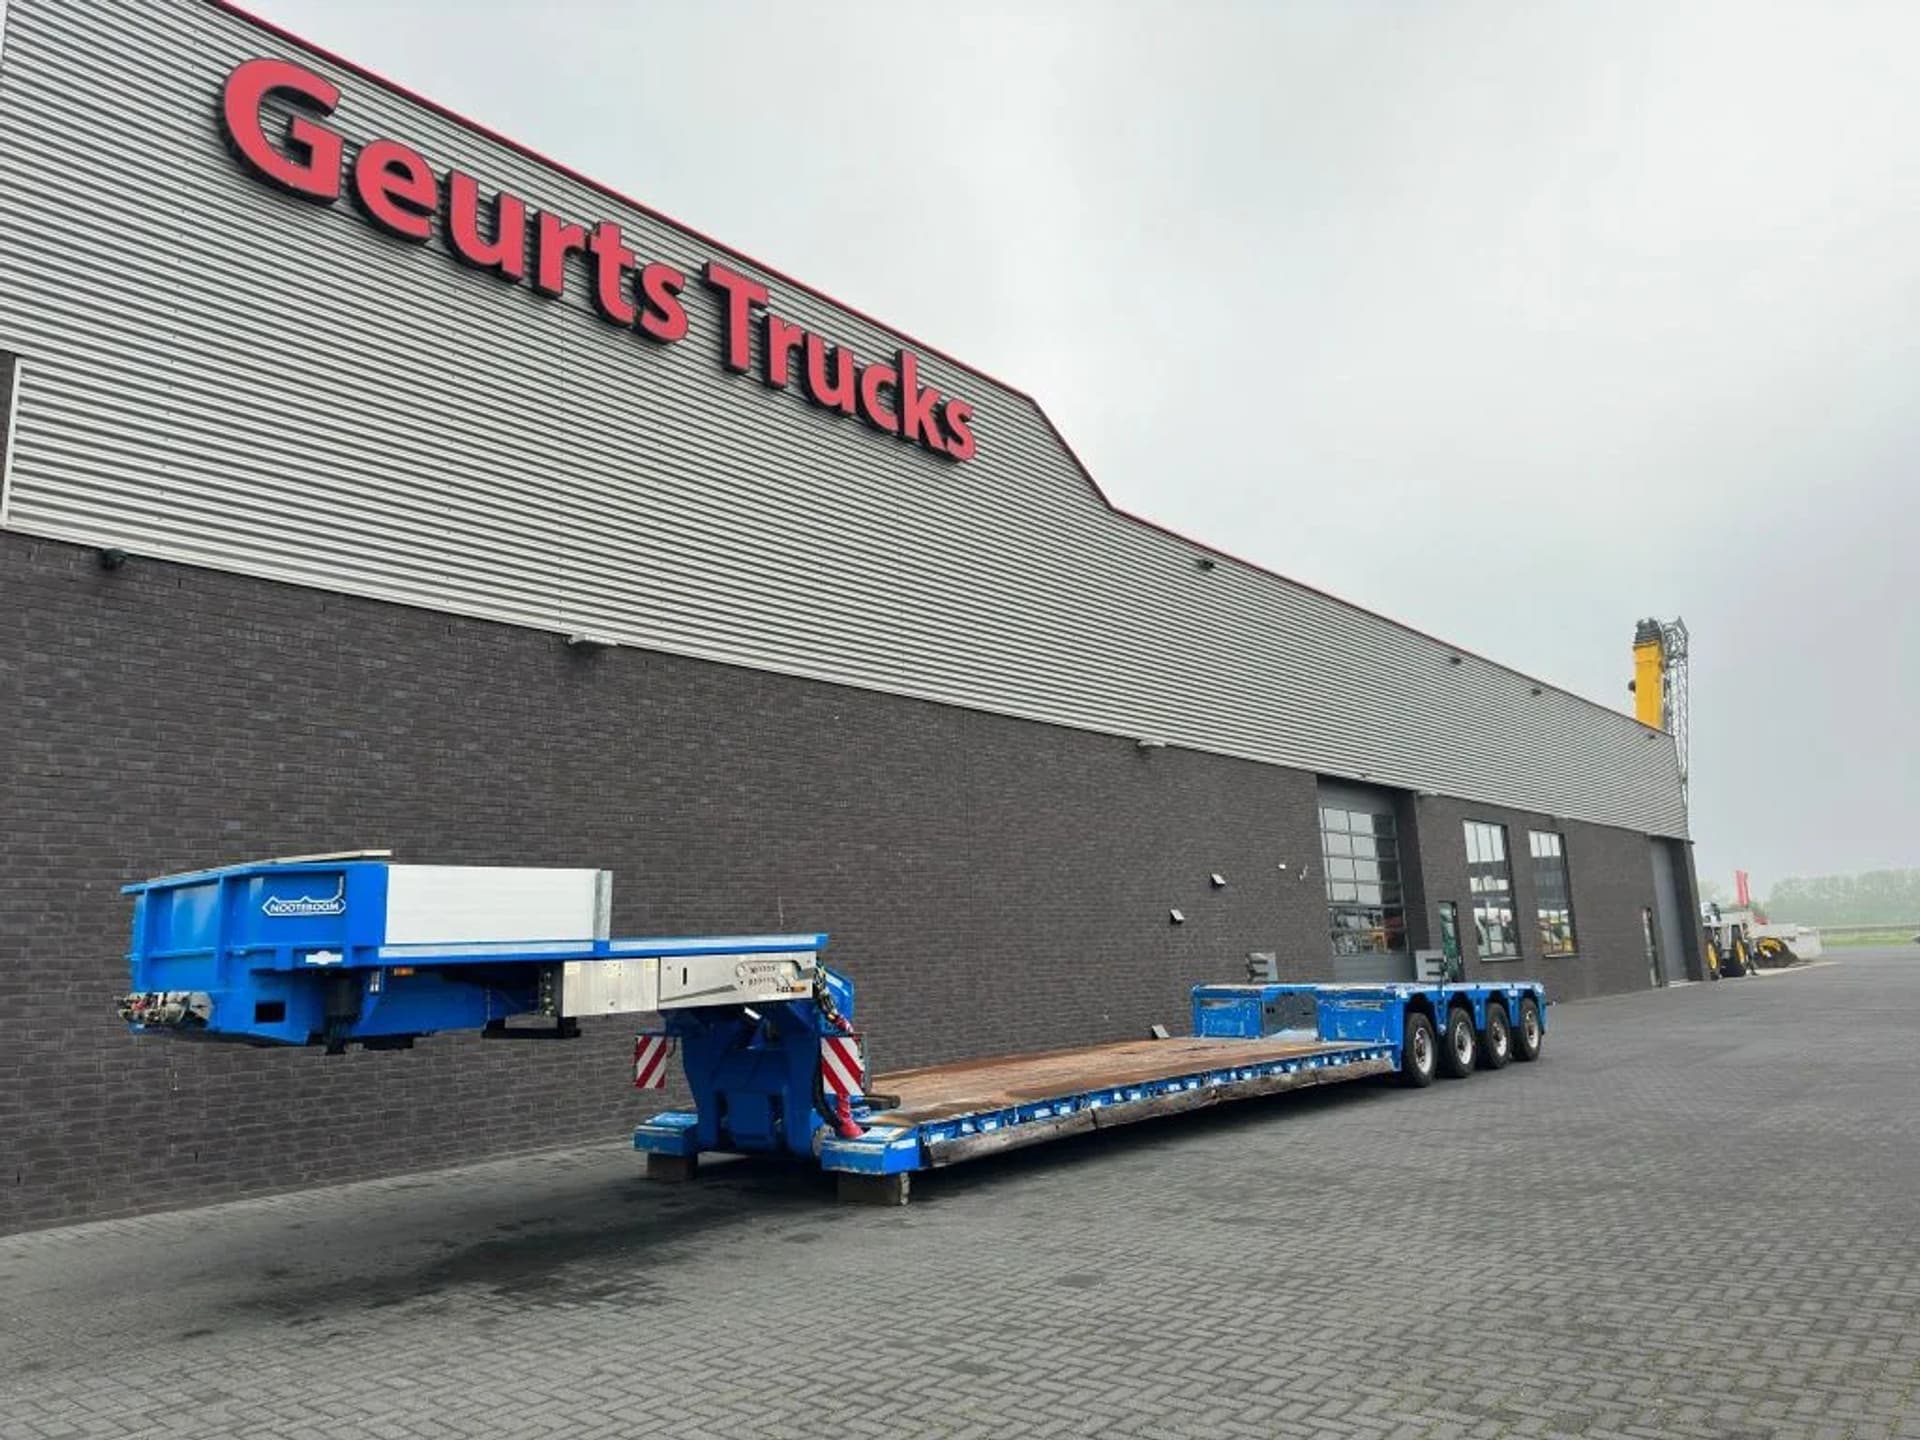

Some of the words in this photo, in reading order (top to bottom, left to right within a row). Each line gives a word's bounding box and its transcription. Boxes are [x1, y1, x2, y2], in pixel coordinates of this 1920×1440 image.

[221, 57, 689, 344] Geurts
[704, 260, 976, 462] Trucks
[269, 901, 340, 914] NOOTEBOOM
